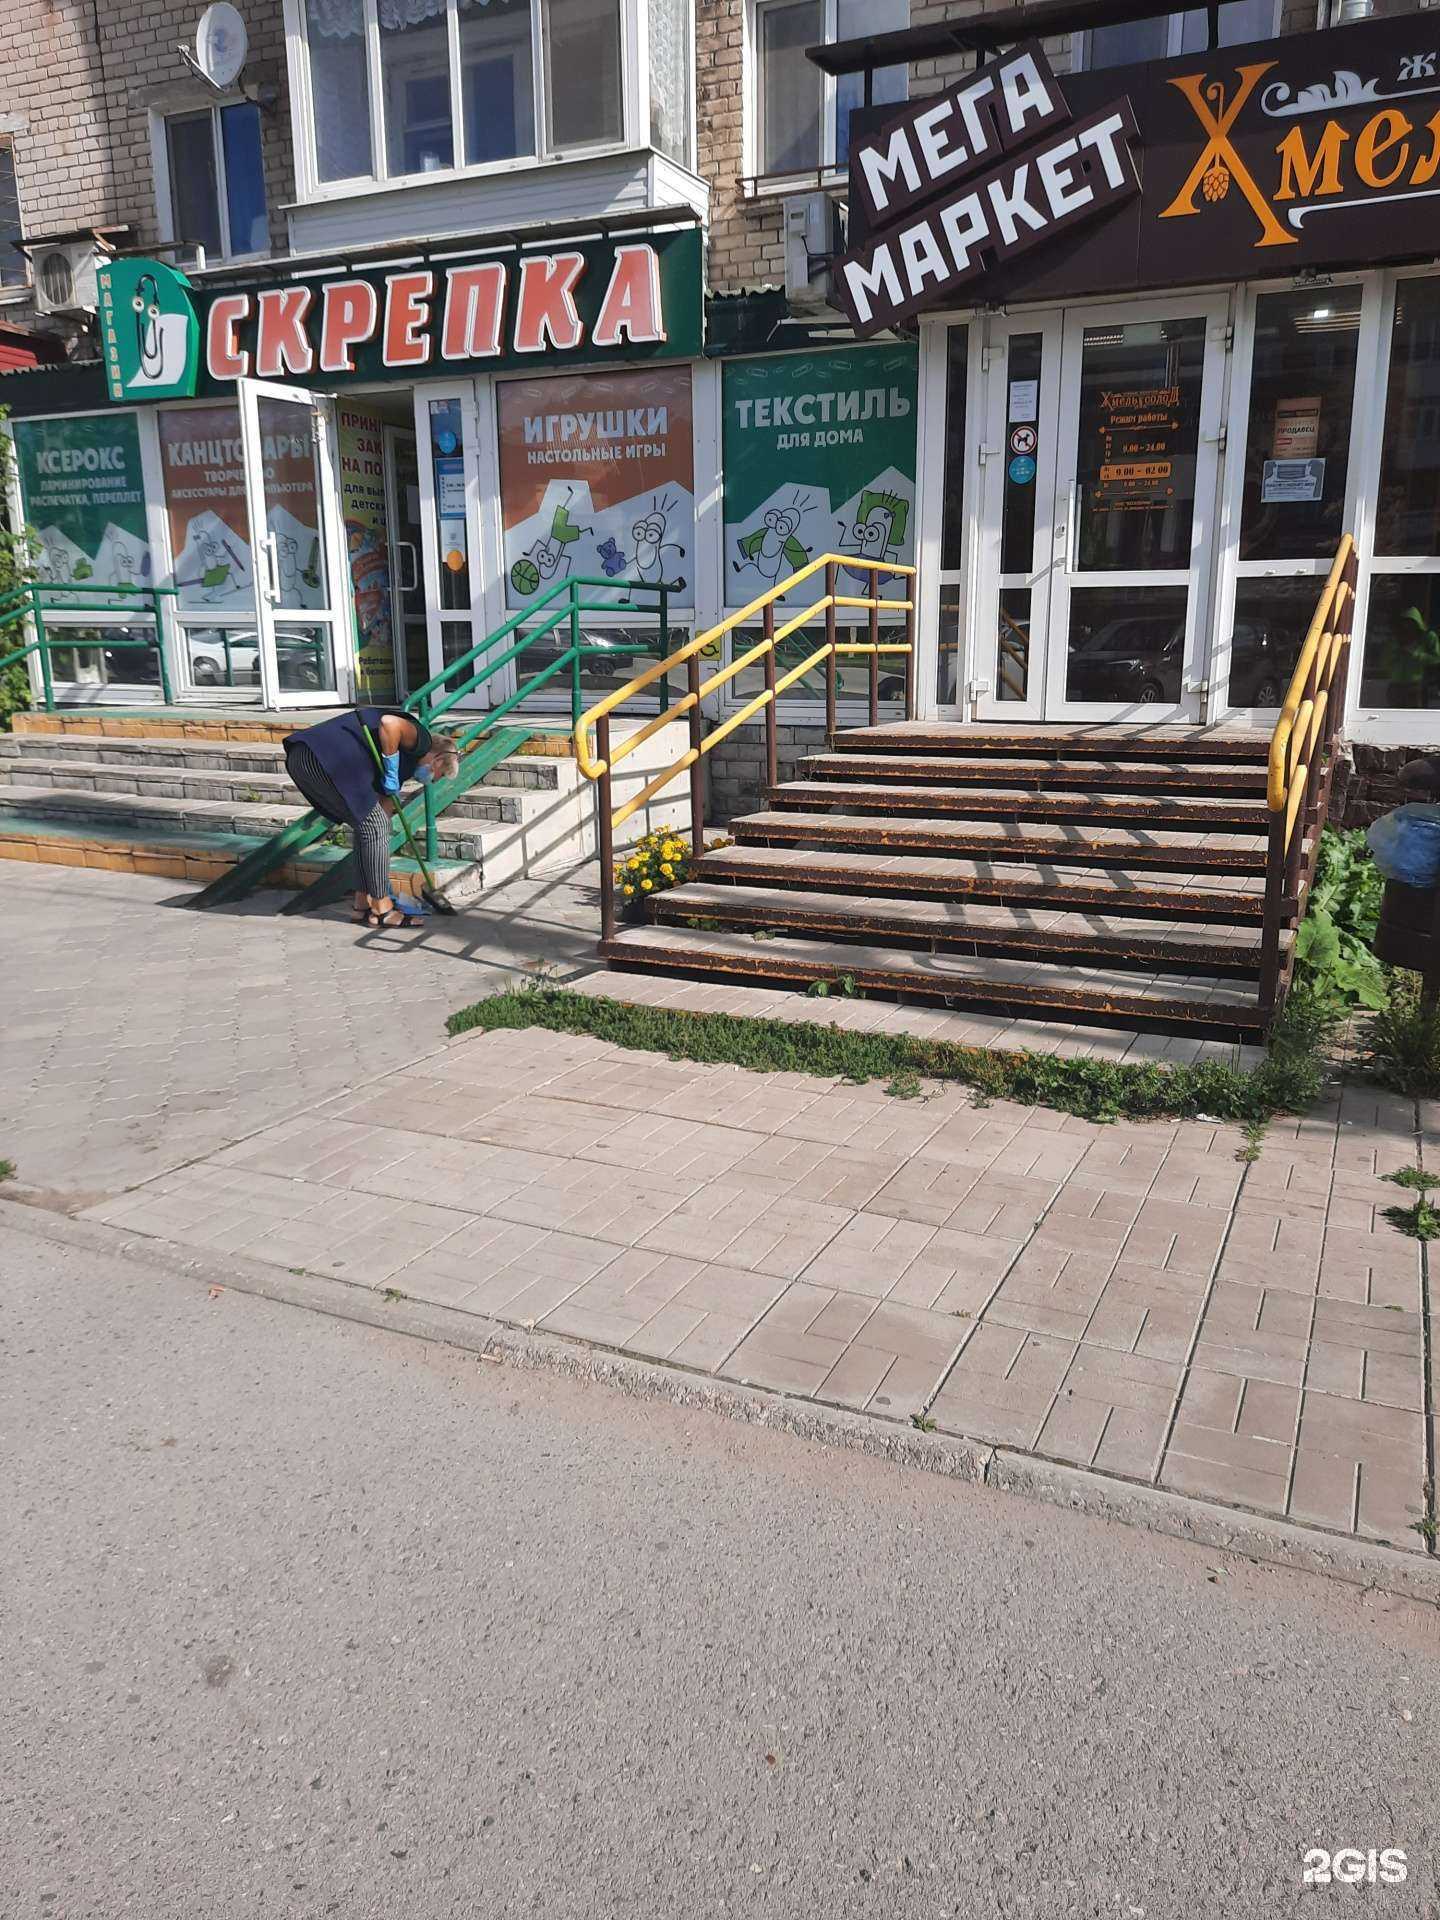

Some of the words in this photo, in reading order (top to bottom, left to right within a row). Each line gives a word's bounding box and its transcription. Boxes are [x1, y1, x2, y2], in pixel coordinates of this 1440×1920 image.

[858, 52, 1055, 212] МЕГА
[842, 112, 1125, 325] МАРКЕТ
[207, 242, 668, 381] СКРЕПКА
[100, 273, 123, 398] МАГАЗИН
[524, 406, 669, 444] ИГРУШКИ
[735, 386, 911, 429] ТЕКСТИЛЬ
[167, 433, 311, 467] КАНЦТОАРЫ
[527, 446, 622, 464] НАСТОЛЬНЫЕ
[626, 443, 666, 459] ИГРЫ
[776, 432, 810, 450] ДЛЯ
[814, 428, 864, 448] ДОМА
[36, 446, 126, 474] КСЕРОКС
[204, 467, 275, 483] ТВОРЧЕО
[341, 456, 361, 474] НА
